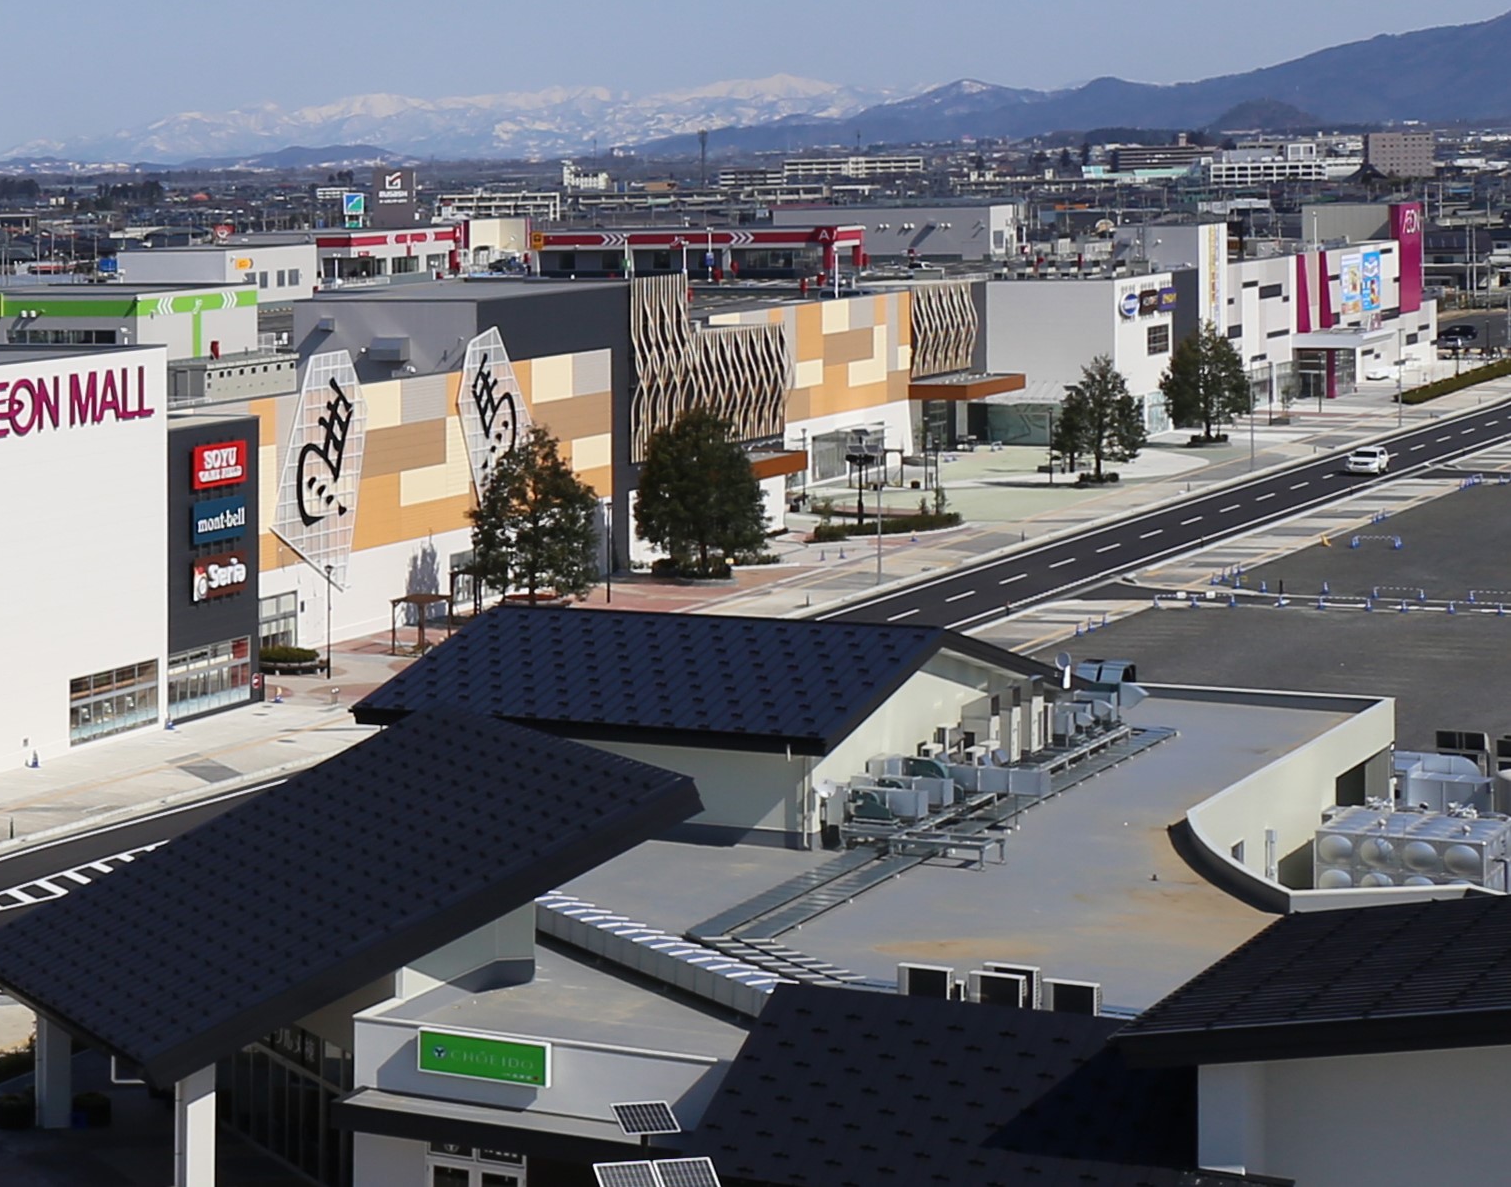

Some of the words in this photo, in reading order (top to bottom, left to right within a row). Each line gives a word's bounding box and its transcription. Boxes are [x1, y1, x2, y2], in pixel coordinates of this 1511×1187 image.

[818, 229, 830, 240] A
[70, 365, 155, 428] MALL
[203, 446, 237, 469] SOYU
[197, 506, 246, 534] mont-bell
[207, 557, 247, 590] Seria
